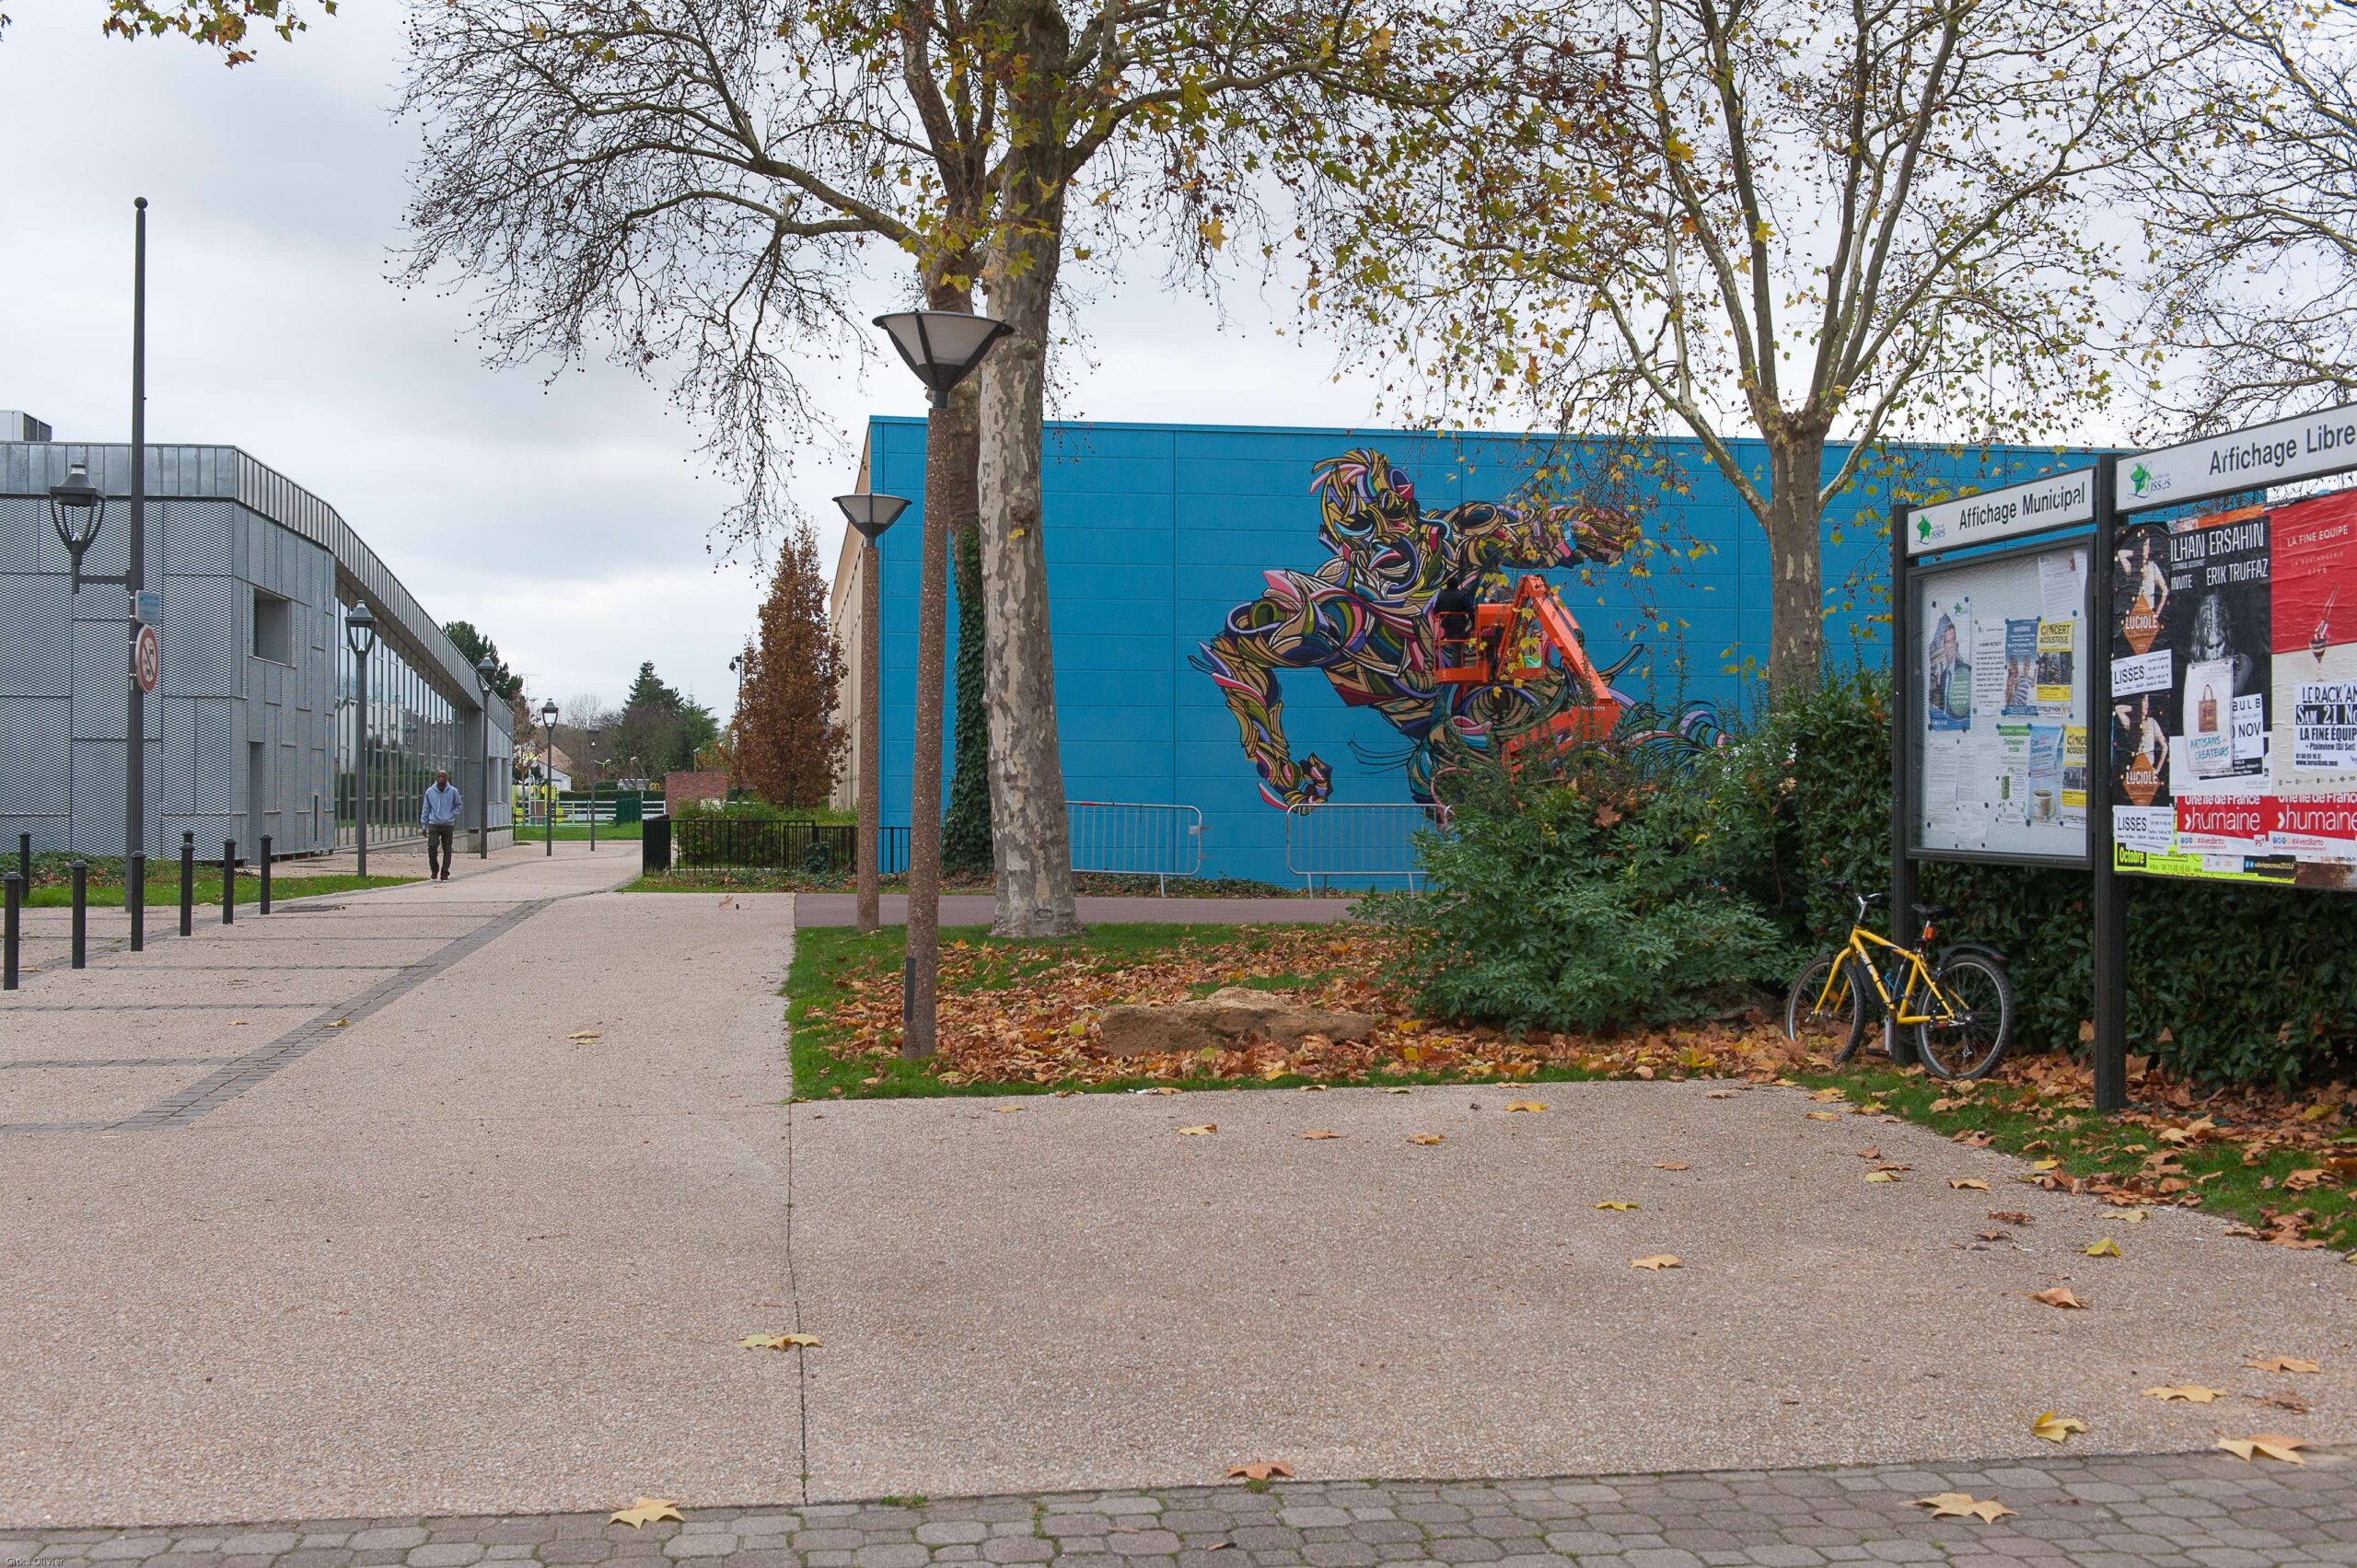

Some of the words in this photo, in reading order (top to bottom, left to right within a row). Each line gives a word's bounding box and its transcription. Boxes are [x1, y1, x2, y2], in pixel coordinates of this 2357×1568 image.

[2210, 438, 2297, 476] Affichage
[2306, 424, 2356, 454] Libre
[1959, 502, 2016, 530] Affichage
[2023, 482, 2085, 517] Municipal
[2170, 533, 2205, 563] ILHAN
[2210, 522, 2264, 556] ERSAHIN
[2287, 537, 2297, 548] LA
[2298, 532, 2316, 545] FINE
[2318, 525, 2349, 540] EQUIPE
[2171, 574, 2192, 590] INVITE
[2206, 564, 2227, 586] ERIK
[2228, 558, 2269, 582] TRUFFAZ
[2125, 614, 2159, 630] LUCIOLE
[2114, 665, 2145, 685] LISSES
[2323, 704, 2339, 725] 21
[2238, 722, 2261, 738] NOV
[2299, 727, 2310, 740] LA
[2311, 727, 2329, 740] FINE
[2189, 736, 2222, 749] ARTISANS
[2126, 771, 2158, 785] LUCIOLE
[2228, 796, 2260, 805] France
[2118, 817, 2147, 831] LISSES
[2192, 807, 2260, 830] humaine
[2286, 805, 2357, 830] humaine
